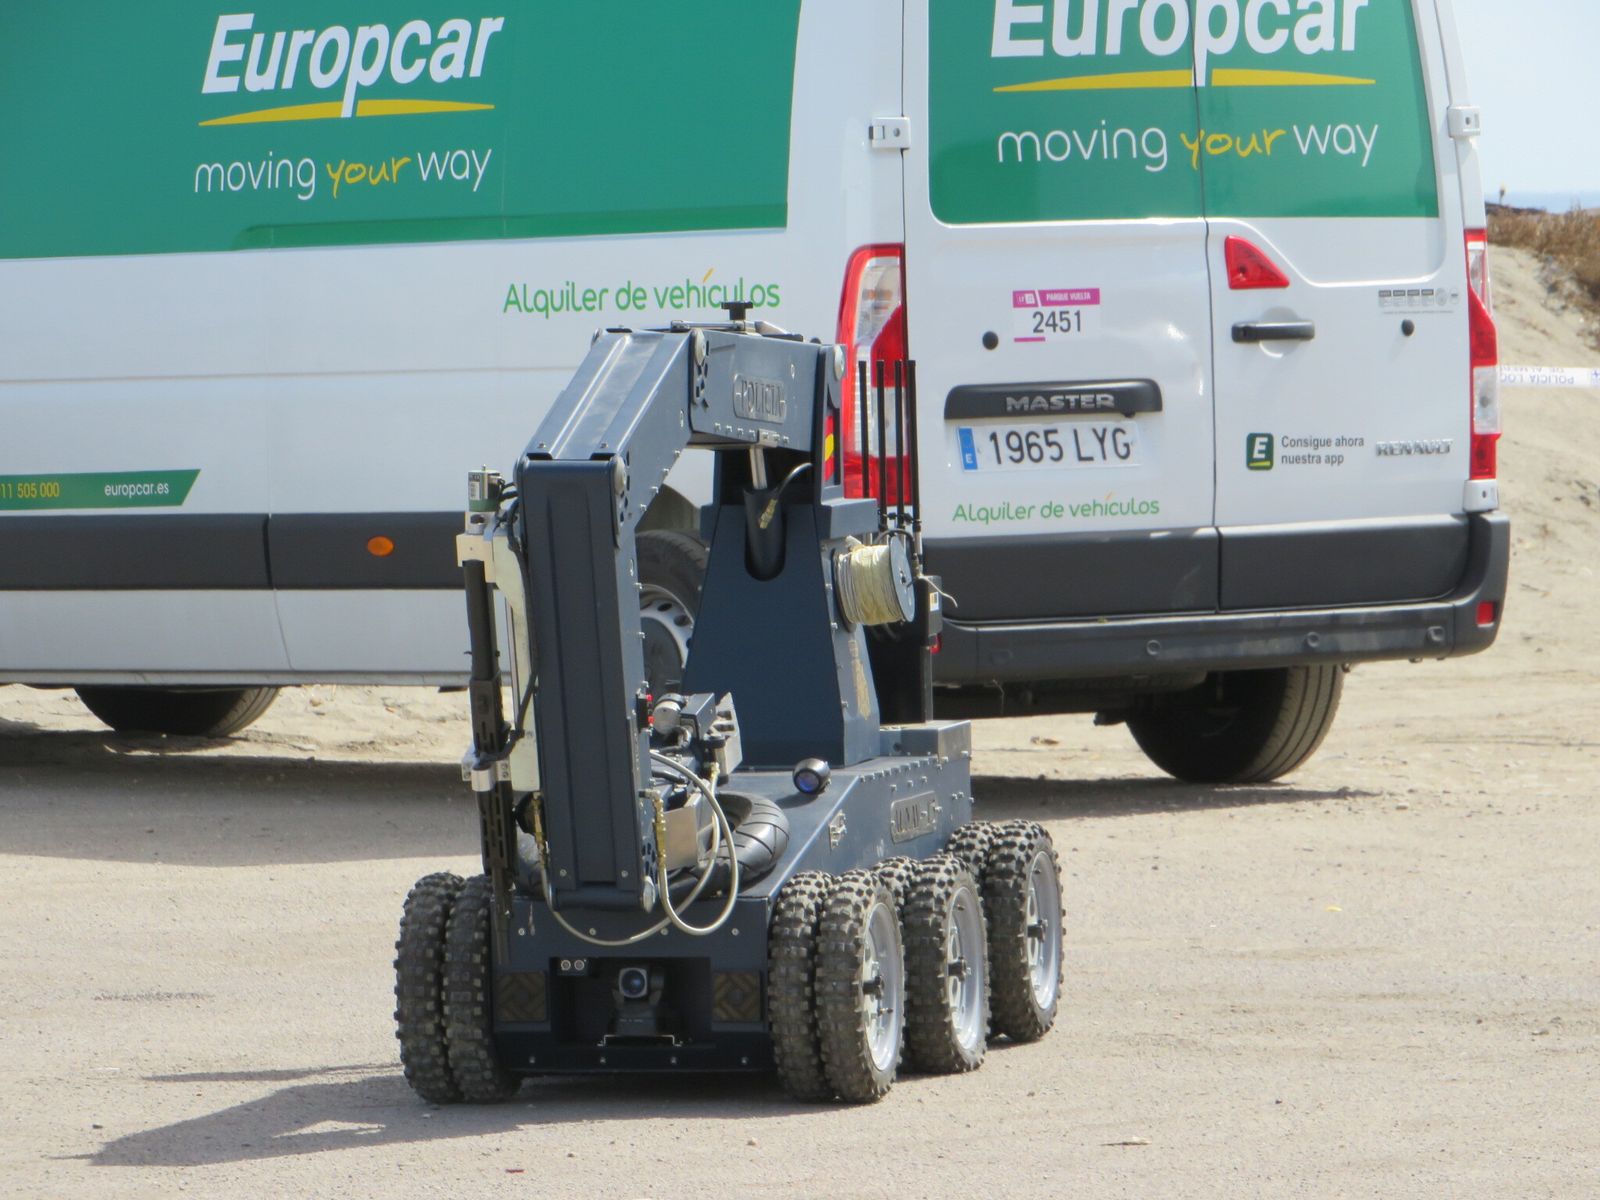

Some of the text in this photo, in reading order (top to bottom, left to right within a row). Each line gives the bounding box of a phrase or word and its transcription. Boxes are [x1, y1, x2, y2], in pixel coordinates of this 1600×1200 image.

[990, 0, 1369, 87] Europcar
[201, 12, 505, 118] Europcar
[998, 119, 1379, 172] moving your way
[194, 149, 492, 200] moving your way
[503, 267, 781, 319] Alquiler de vehículos
[1032, 309, 1082, 333] 2451
[1006, 393, 1116, 412] MASTER
[988, 426, 1131, 465] 1965 LYG
[1253, 436, 1269, 459] E
[1281, 435, 1365, 451] Consigue ahora
[1376, 438, 1453, 456] RENAULT
[965, 453, 974, 464] E
[1281, 453, 1345, 467] nuestra app
[17, 482, 38, 499] 505
[40, 482, 61, 498] 000
[104, 481, 170, 499] europcar.es
[952, 491, 1160, 525] Alquiler de vehículos
